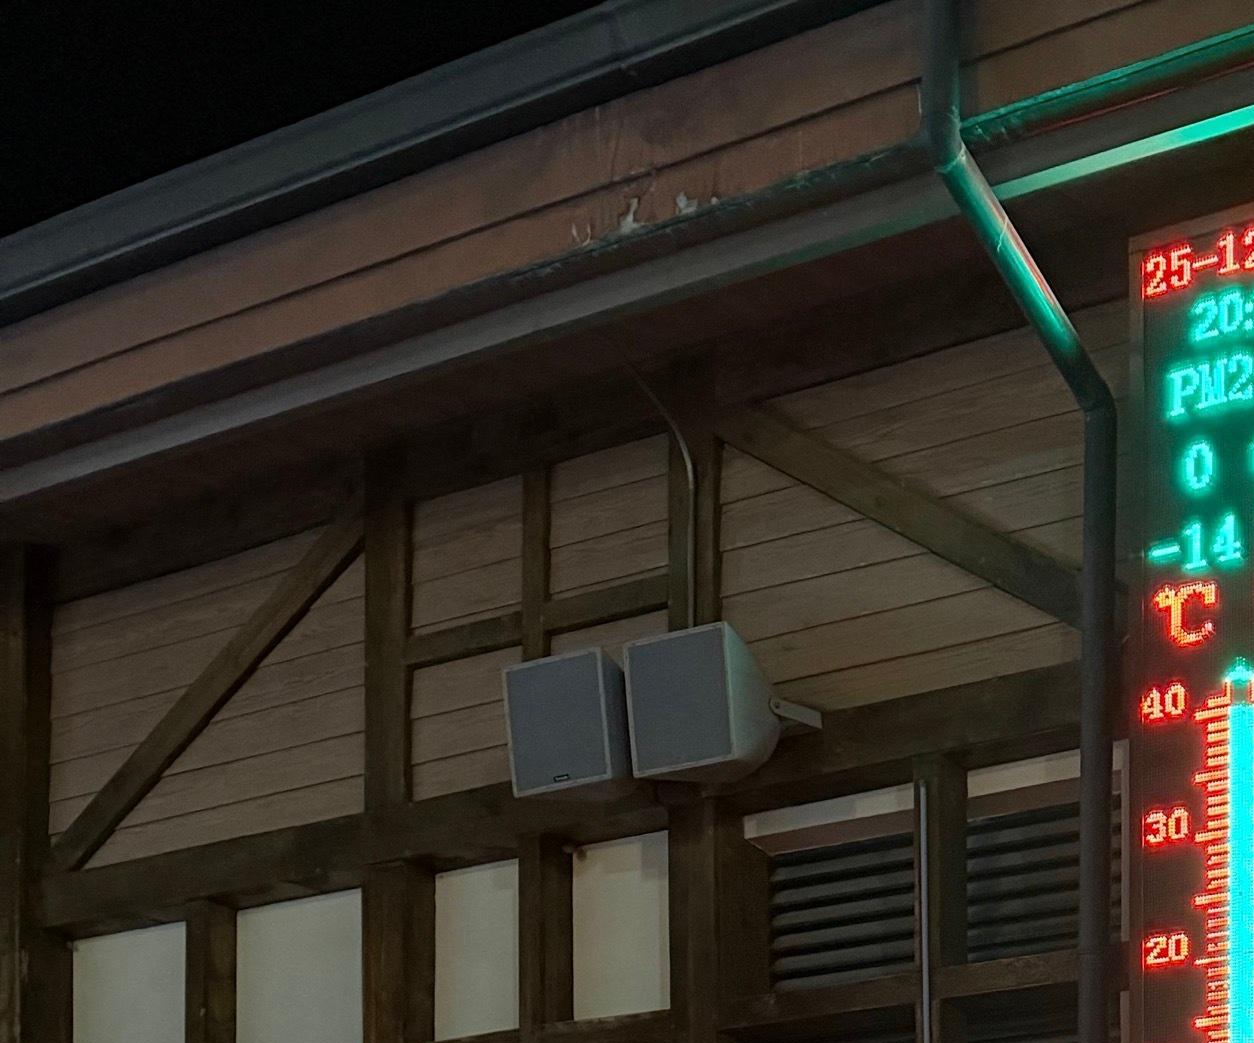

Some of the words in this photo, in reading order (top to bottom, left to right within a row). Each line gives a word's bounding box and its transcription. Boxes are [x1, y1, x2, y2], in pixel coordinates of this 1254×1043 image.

[1183, 441, 1214, 490] 0
[1147, 512, 1243, 571] -14
[1141, 682, 1187, 720] 40
[1145, 806, 1189, 845] 30
[1145, 932, 1189, 966] 20
